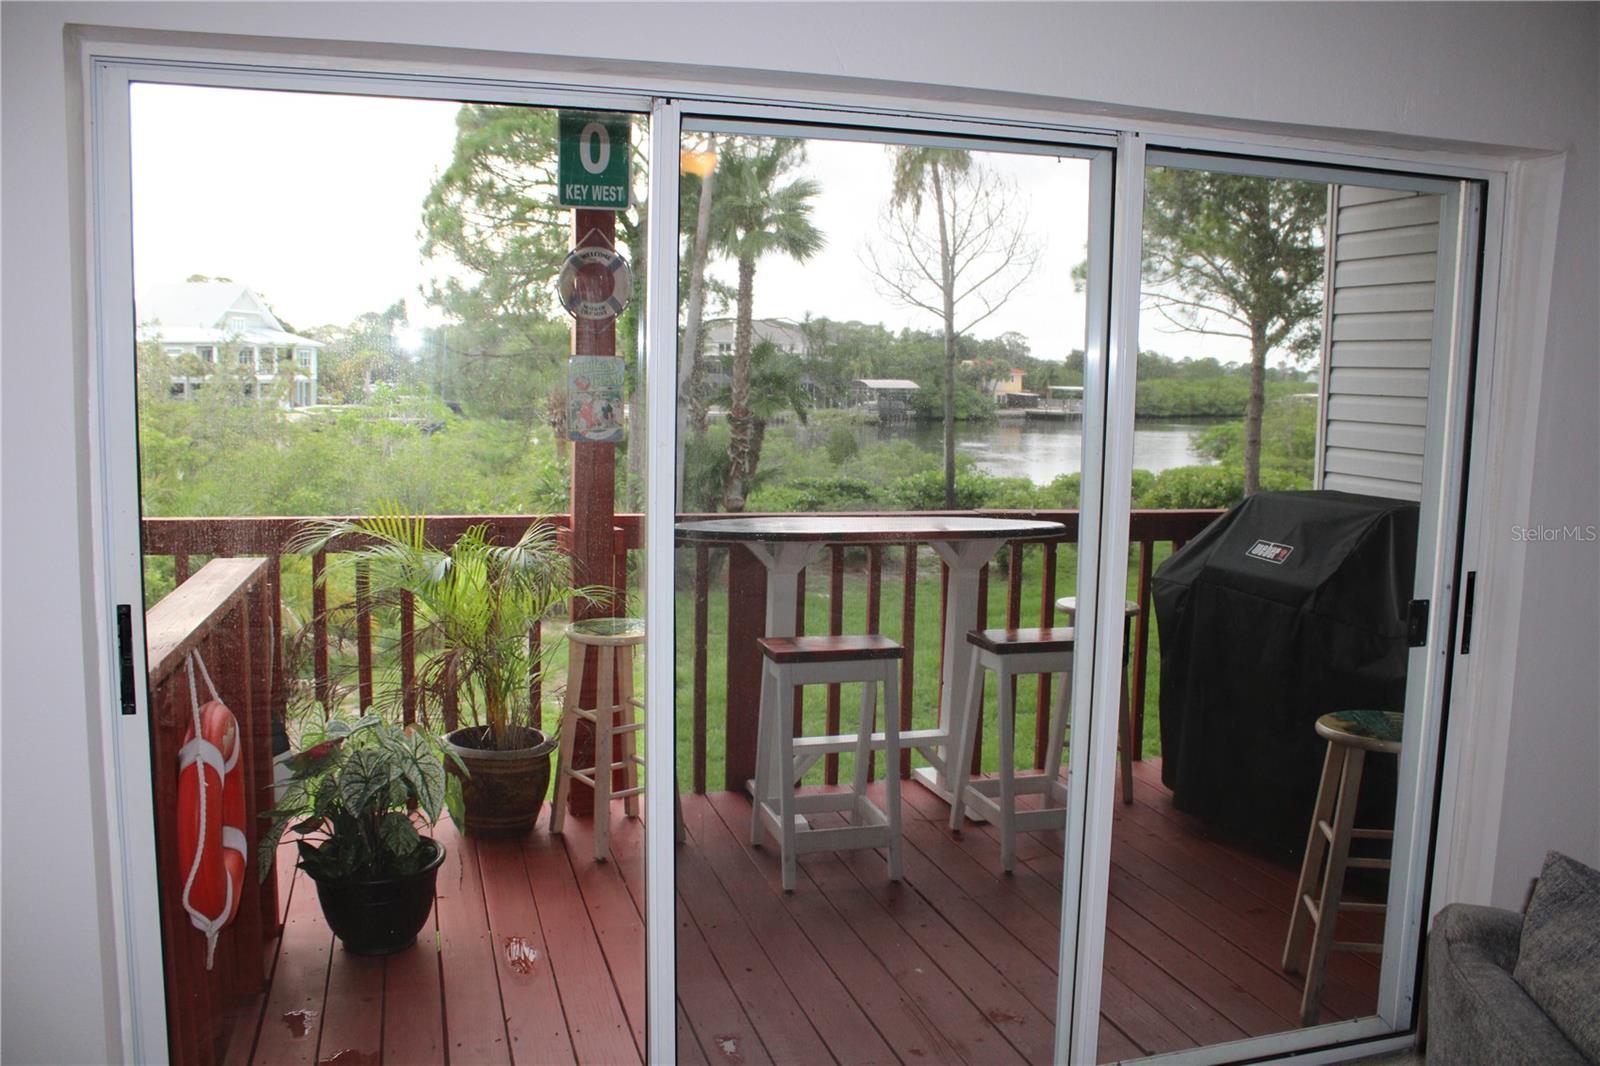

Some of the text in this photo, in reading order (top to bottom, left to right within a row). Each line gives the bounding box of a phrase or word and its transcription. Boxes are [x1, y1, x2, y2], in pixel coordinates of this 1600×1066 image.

[580, 122, 610, 174] 0
[565, 184, 624, 202] KEY WEST
[582, 250, 611, 260] WELCOME
